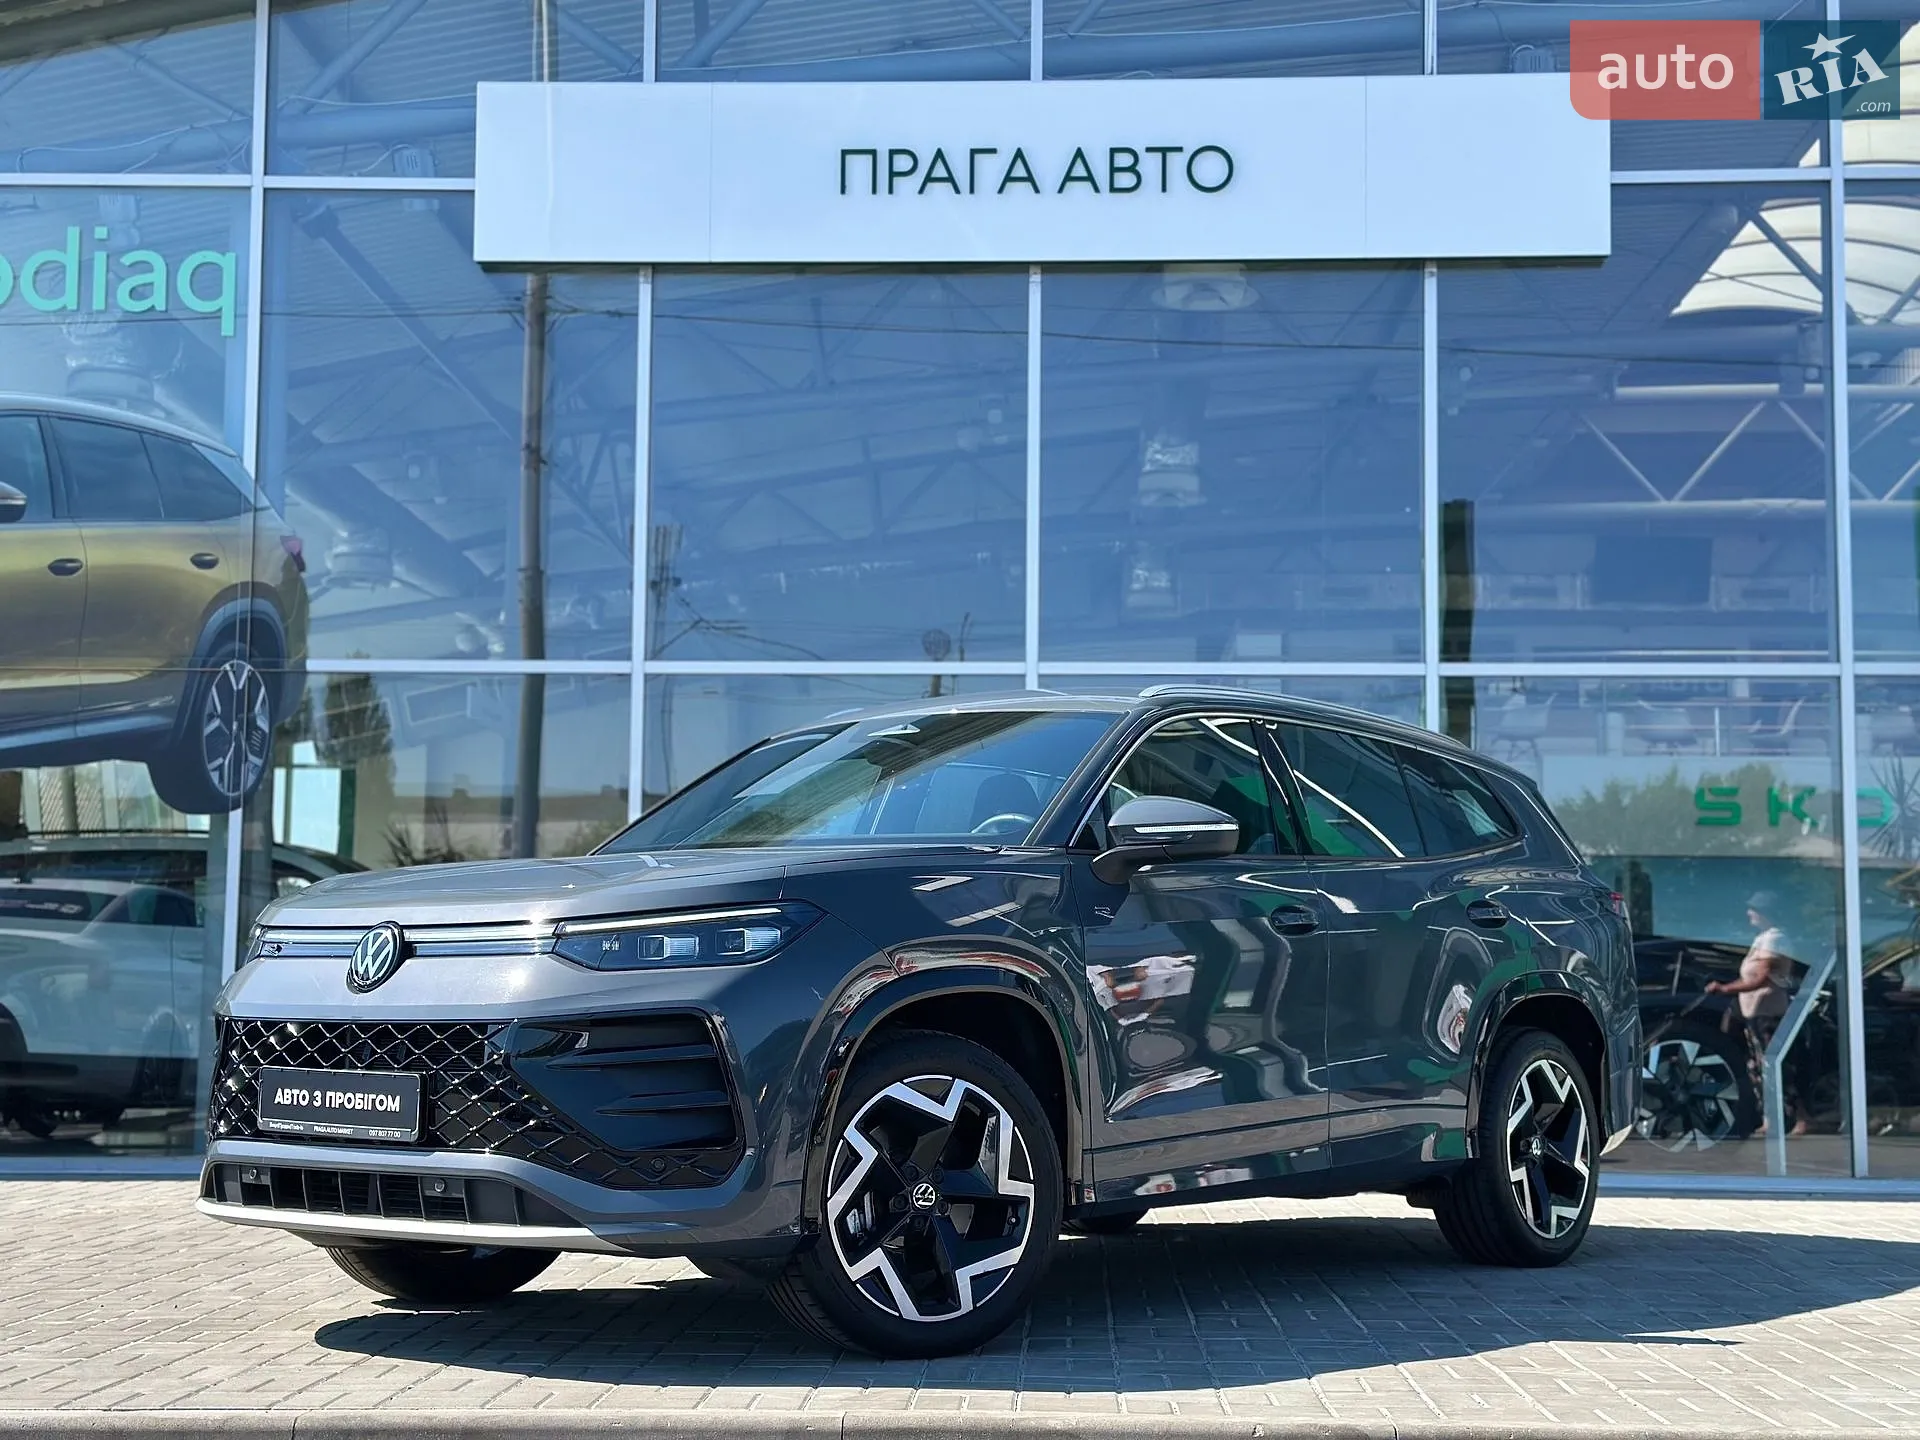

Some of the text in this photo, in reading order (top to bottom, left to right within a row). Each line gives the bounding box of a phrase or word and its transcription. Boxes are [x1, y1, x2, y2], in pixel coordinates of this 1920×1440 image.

[840, 145, 1234, 195] ПРАГА АВТО
[0, 226, 236, 337] diaq
[274, 1087, 309, 1106] АВТО
[325, 1091, 400, 1112] ПРОБІГОМ
